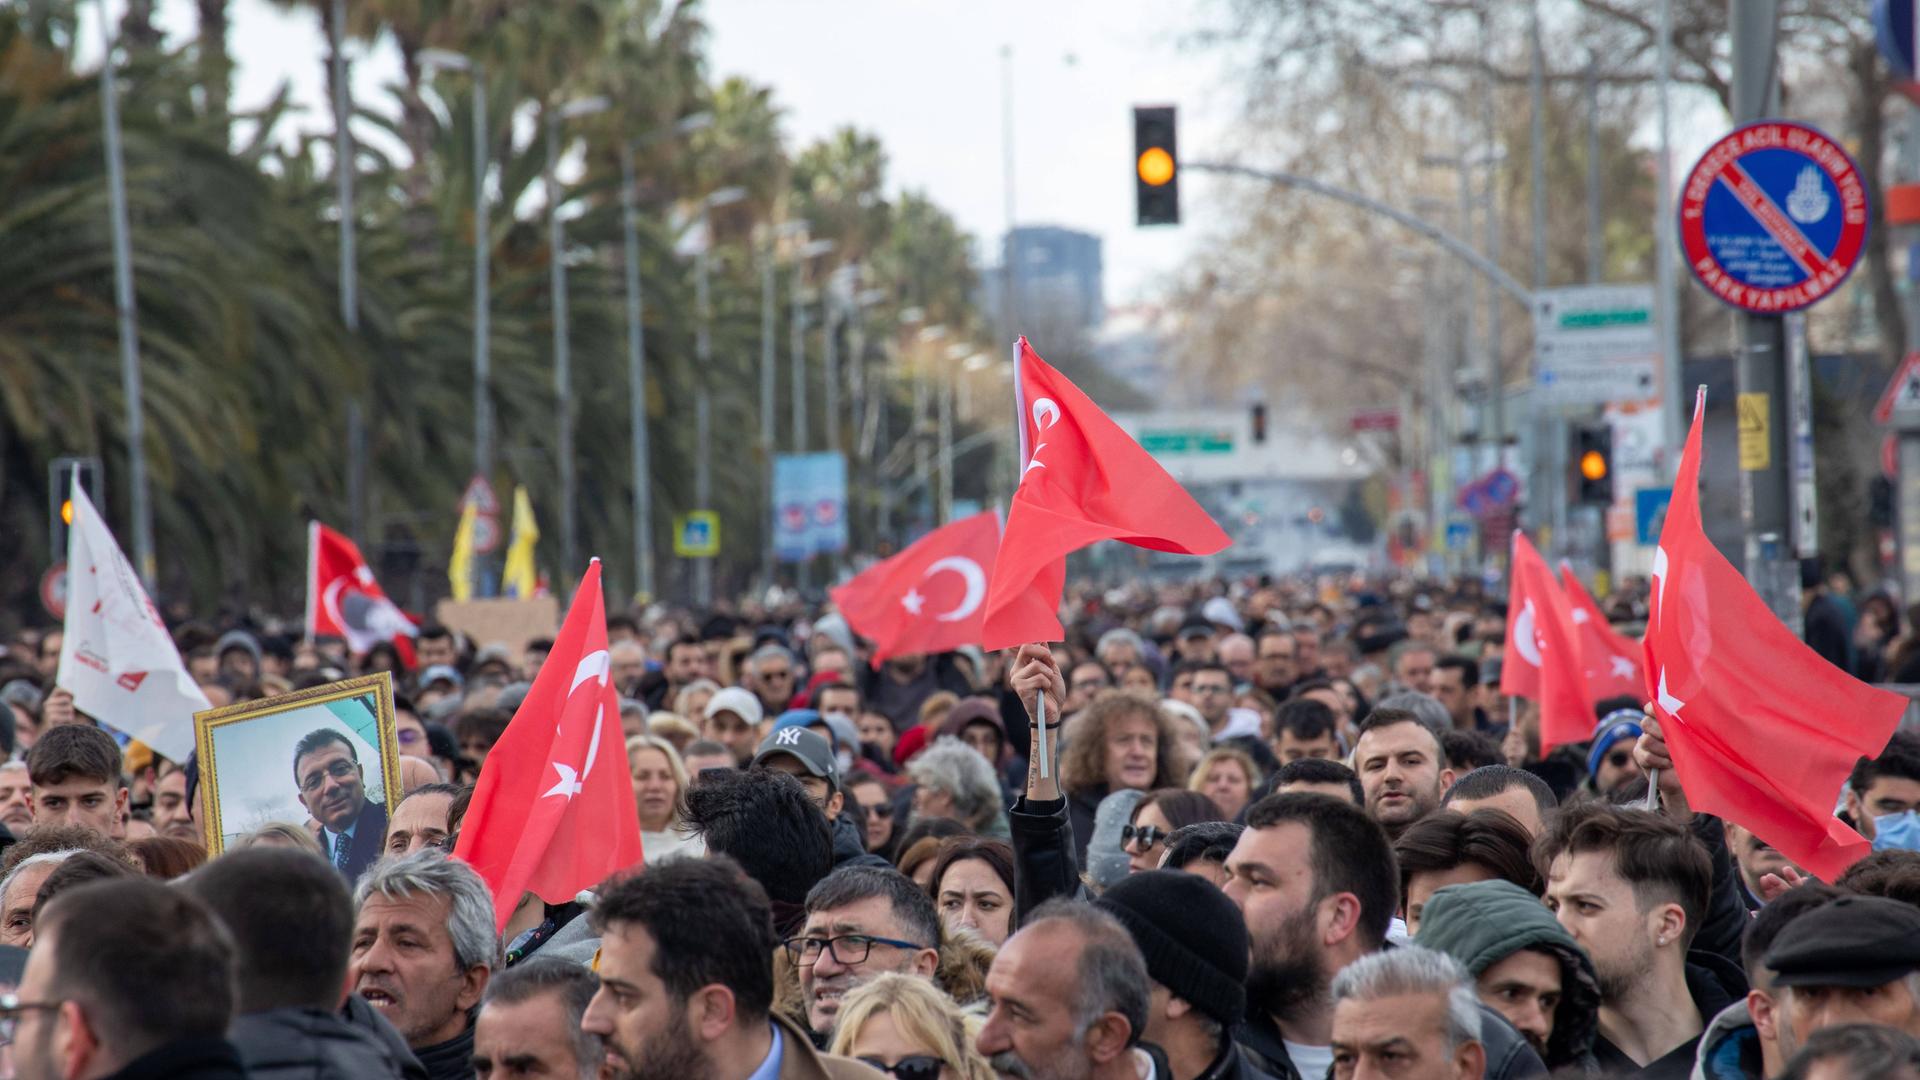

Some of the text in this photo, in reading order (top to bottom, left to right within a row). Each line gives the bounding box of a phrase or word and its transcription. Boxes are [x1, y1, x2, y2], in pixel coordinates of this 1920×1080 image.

[1839, 171, 1866, 224] YOLU
[1695, 256, 1848, 310] PARK YAPILMAZ
[775, 727, 802, 745] NY
